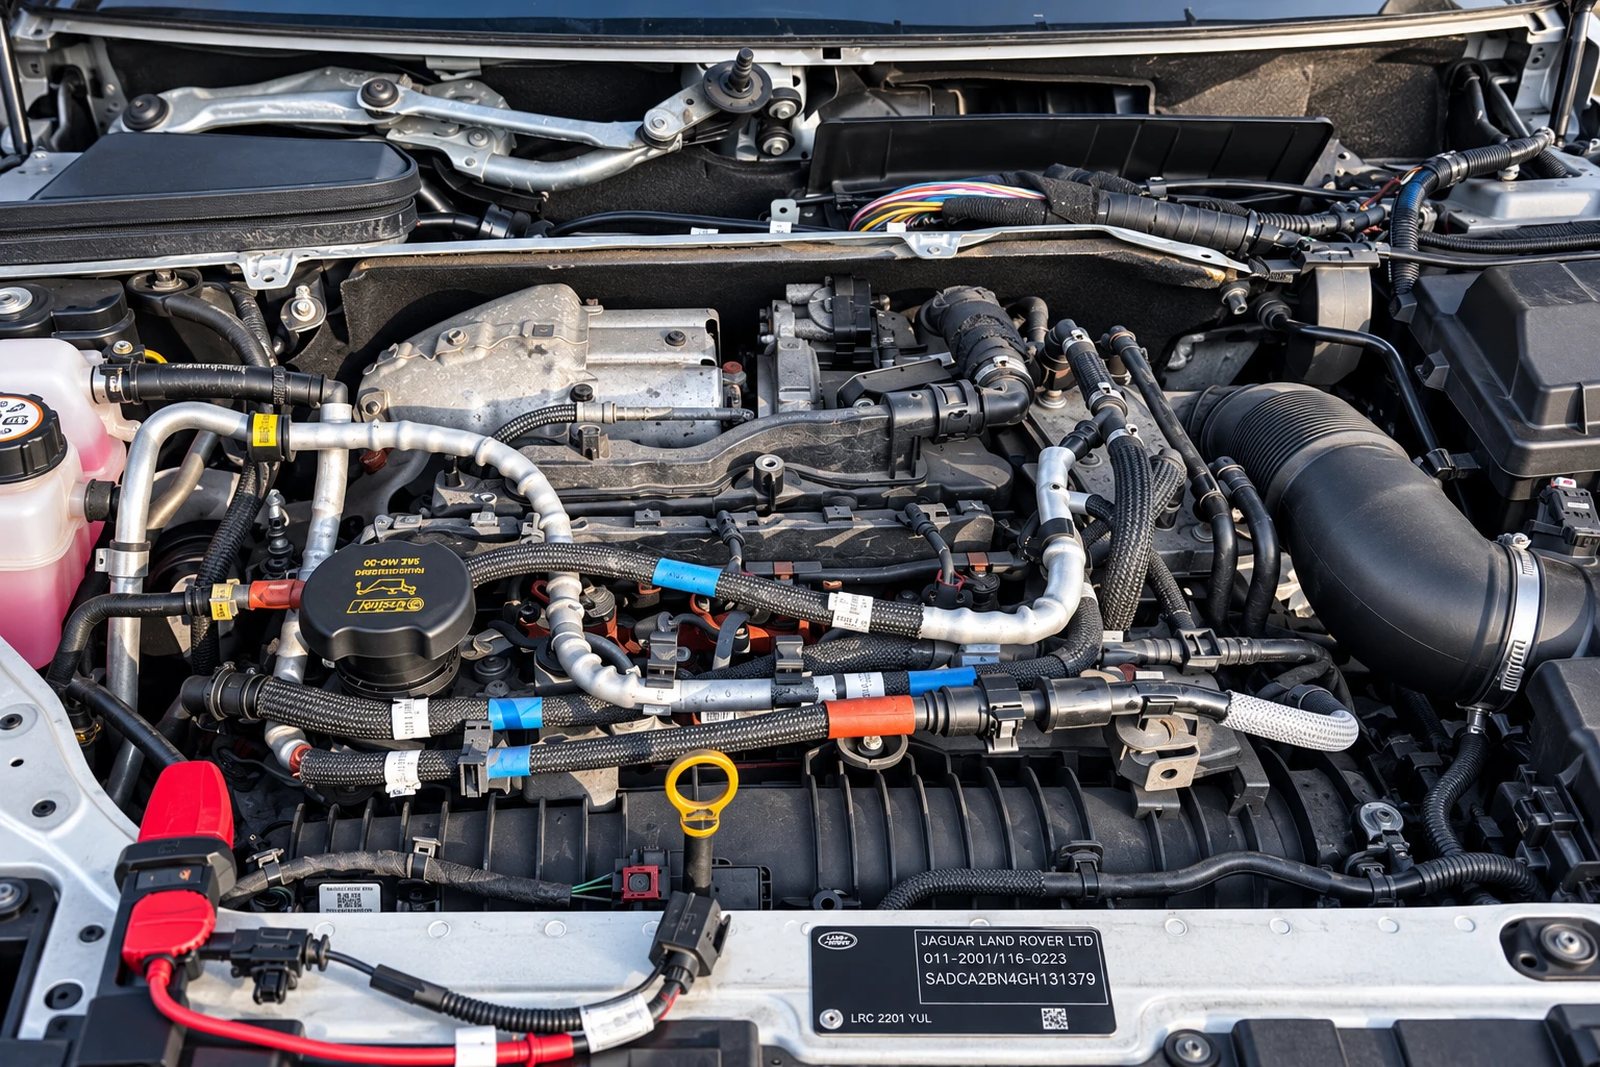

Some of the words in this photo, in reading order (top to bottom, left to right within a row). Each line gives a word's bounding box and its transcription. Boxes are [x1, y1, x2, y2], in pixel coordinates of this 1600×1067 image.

[920, 935, 975, 947] JAGUAR
[978, 935, 1016, 947] LAND
[1018, 935, 1065, 947] ROVER
[1068, 935, 1094, 947] LTD
[923, 952, 1067, 965] 011-2001/116-0223
[925, 971, 1096, 987] SADCA2BN4GH131379
[850, 1013, 875, 1024] LRC
[877, 1013, 905, 1024] 2201
[907, 1013, 933, 1024] YUL
